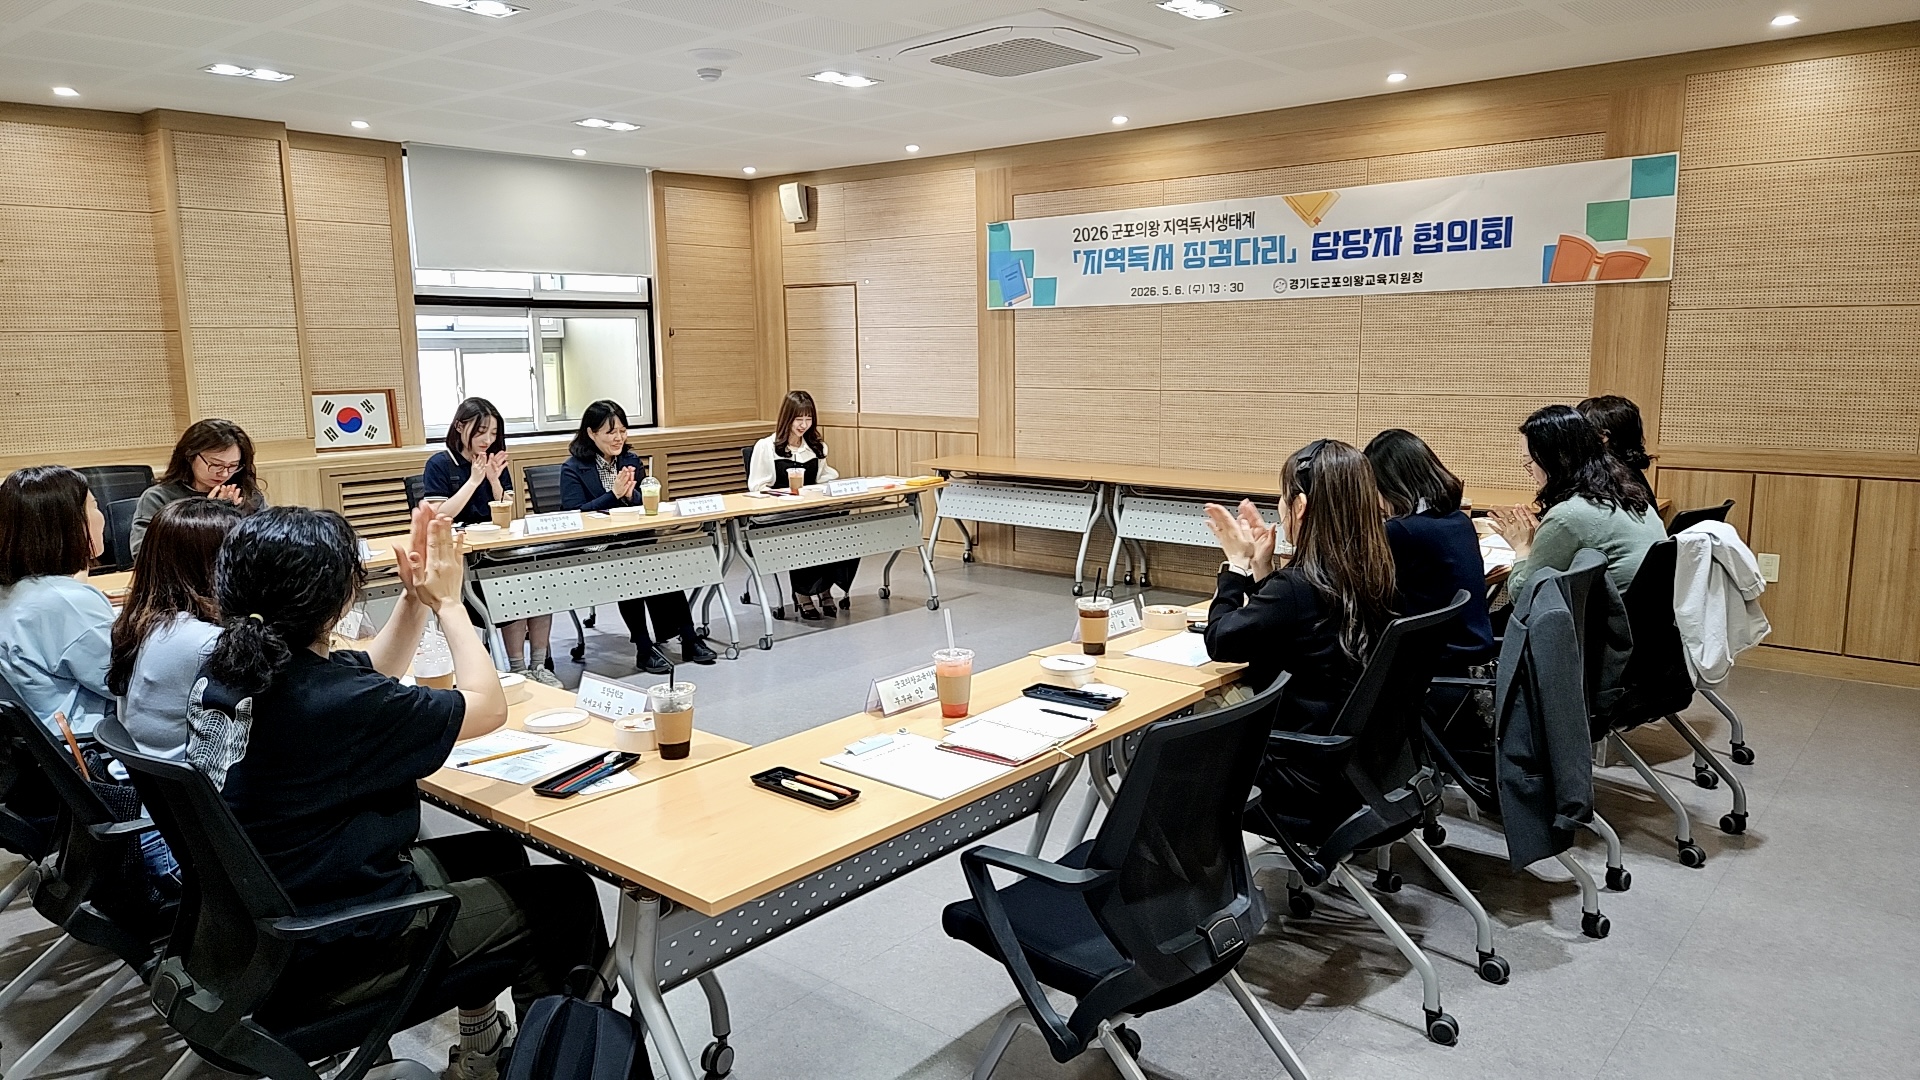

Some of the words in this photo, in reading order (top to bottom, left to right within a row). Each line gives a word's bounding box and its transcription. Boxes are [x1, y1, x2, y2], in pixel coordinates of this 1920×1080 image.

[1072, 225, 1109, 243] 2026
[1111, 222, 1161, 241] 군포의왕
[1162, 211, 1256, 236] 지역독서생태계
[1311, 225, 1403, 262] 담당자
[1413, 215, 1514, 254] 협의회
[1130, 286, 1160, 297] 2026.
[1162, 285, 1172, 296] 5.
[1174, 285, 1185, 295] 6.
[1289, 271, 1424, 291] 경기도군포의왕교육지원청
[914, 686, 924, 699] 안
